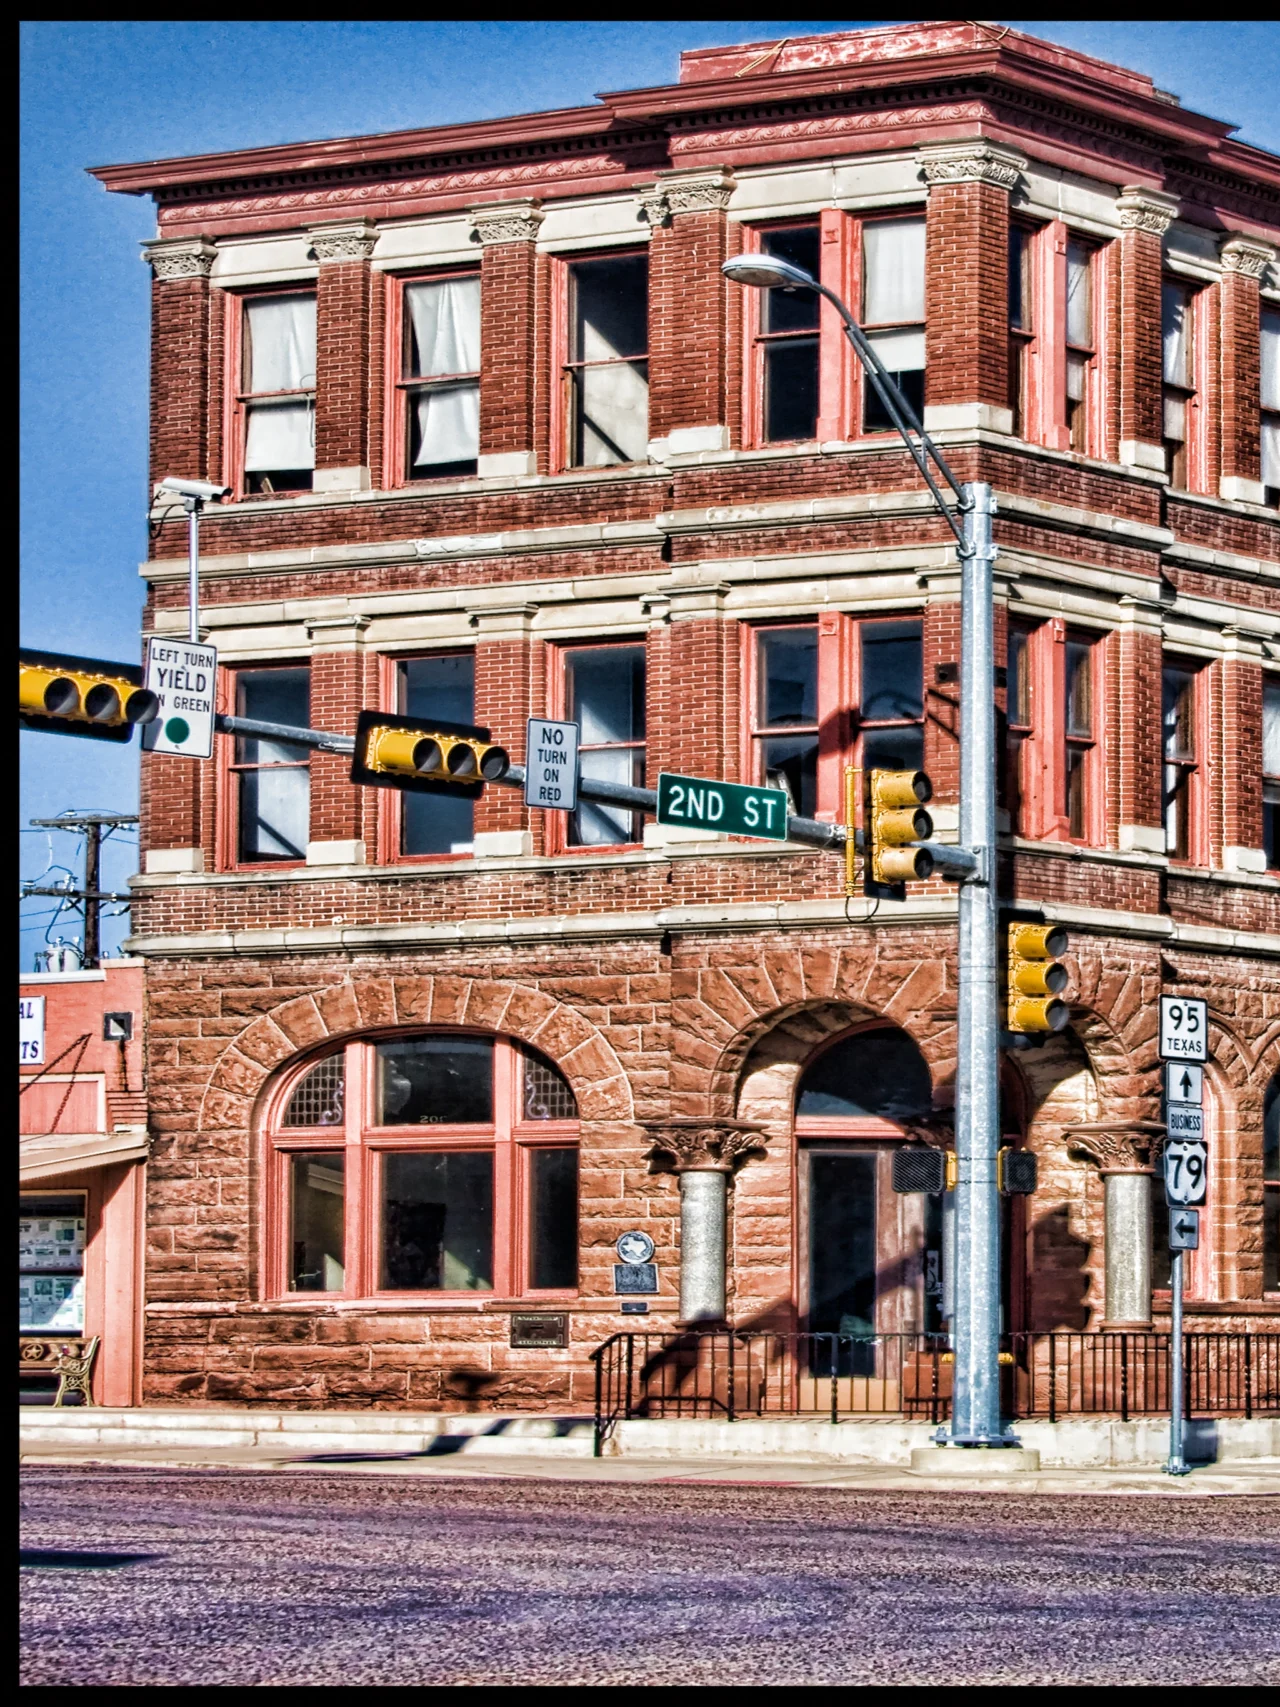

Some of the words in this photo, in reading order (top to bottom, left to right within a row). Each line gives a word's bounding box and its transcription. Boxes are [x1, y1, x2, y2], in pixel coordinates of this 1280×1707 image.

[152, 647, 179, 663] LEFT
[184, 652, 213, 668] TURN
[157, 667, 206, 692] YIELD
[173, 695, 210, 713] GREEN
[542, 727, 564, 746] NO
[537, 749, 567, 765] TURN
[543, 768, 560, 783] ON
[539, 786, 562, 801] RED
[668, 785, 724, 821] 2ND
[743, 796, 777, 829] ST
[1169, 1005, 1200, 1033] 95
[19, 1040, 39, 1059] TS
[1167, 1037, 1202, 1053] TEXAS
[1171, 1113, 1201, 1131] BUSINESS
[1168, 1154, 1201, 1190] 79
